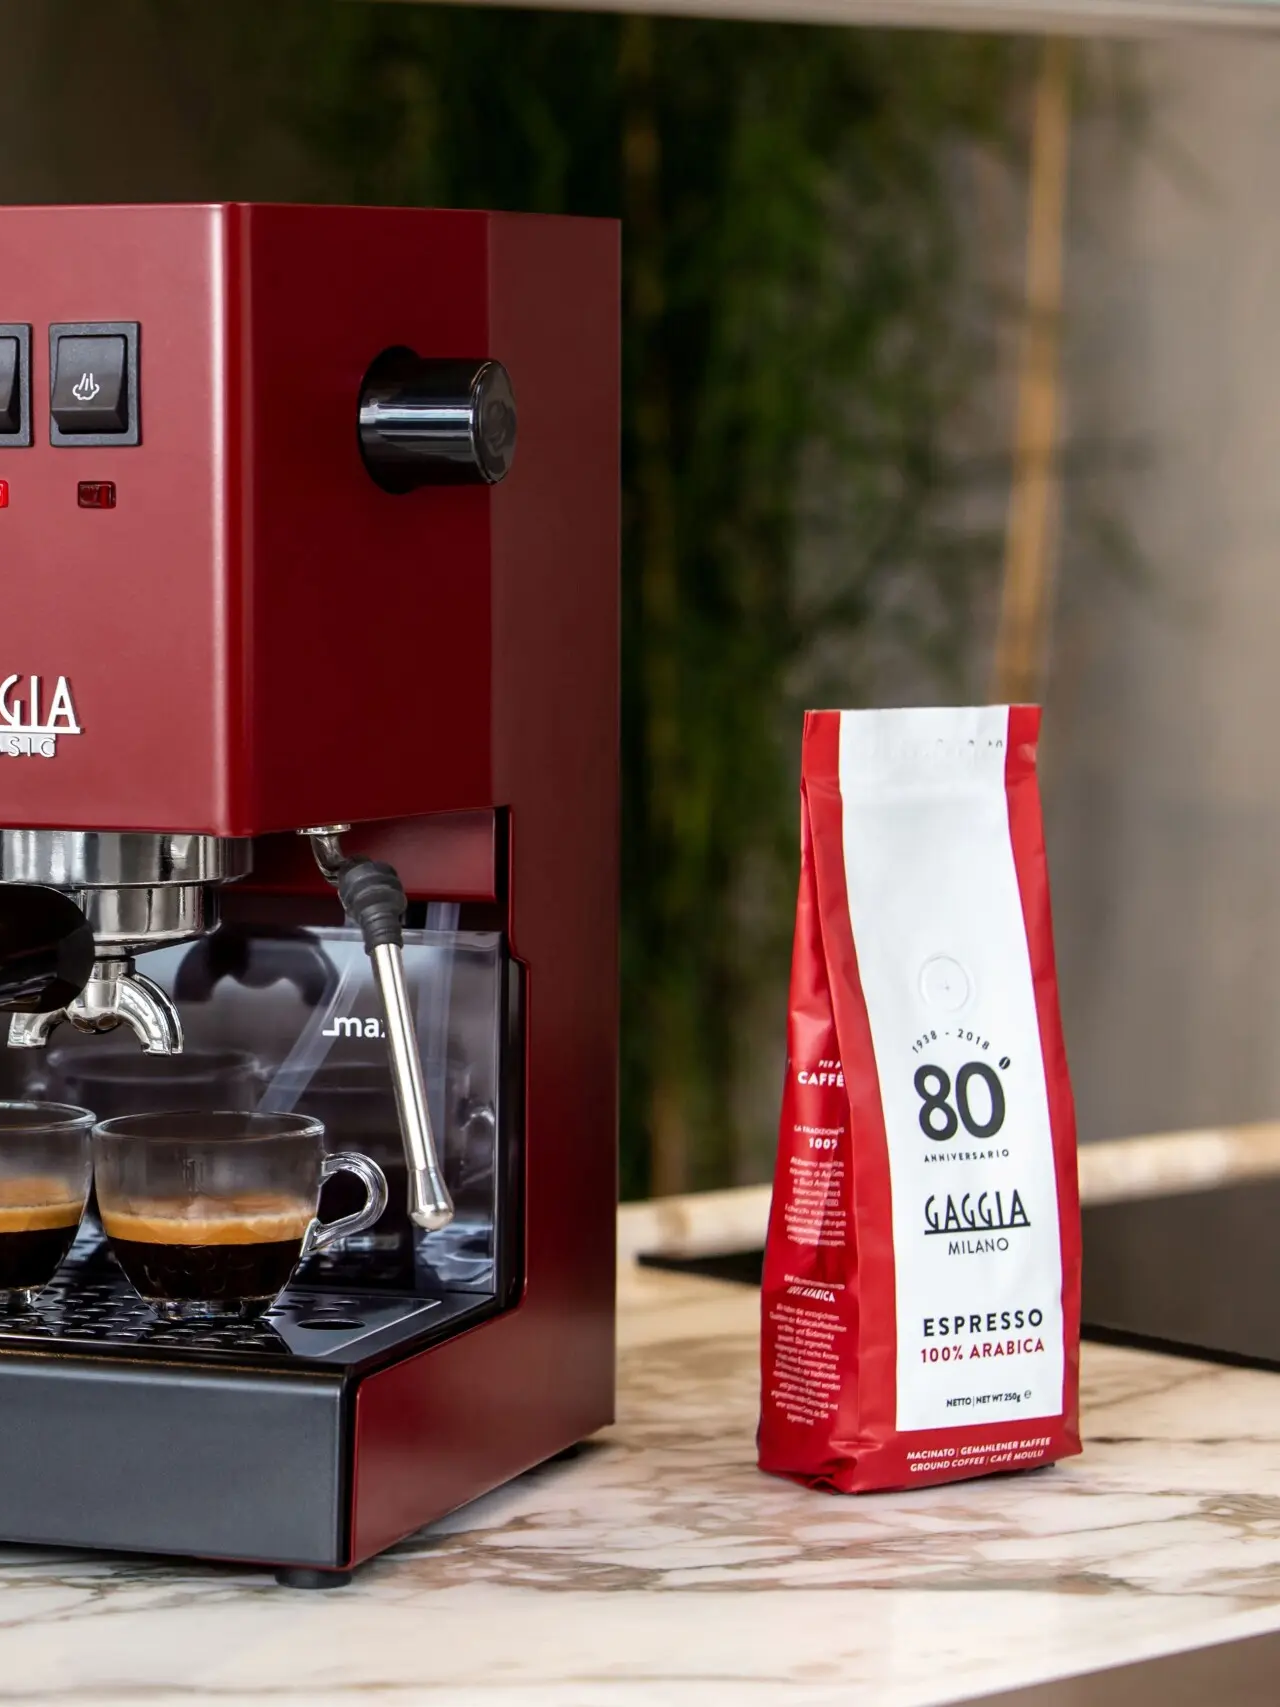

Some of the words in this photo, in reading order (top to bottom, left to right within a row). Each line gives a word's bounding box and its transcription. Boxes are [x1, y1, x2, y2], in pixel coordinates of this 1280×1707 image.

[333, 1016, 386, 1038] ma
[912, 1030, 938, 1053] 1938
[957, 1028, 990, 1050] 2018
[924, 1149, 1010, 1163] ANNIVERSARIO
[924, 1188, 1031, 1235] GAGGIA
[948, 1237, 1009, 1256] MILANO
[923, 1308, 1043, 1337] ESPRESSO
[920, 1345, 963, 1363] 100%
[969, 1338, 1045, 1359] ARABICA
[946, 1397, 972, 1407] NETTO
[976, 1395, 991, 1404] NET
[1004, 1392, 1021, 1402] 250g
[907, 1448, 955, 1460] MACINATO
[960, 1441, 1018, 1455] GEMAHLENER
[1019, 1437, 1051, 1448] KAFFEE
[910, 1461, 950, 1472] GROUND
[951, 1456, 985, 1468] COFFEE
[990, 1452, 1012, 1463] CAFÉ
[1013, 1449, 1044, 1461] MOULU
